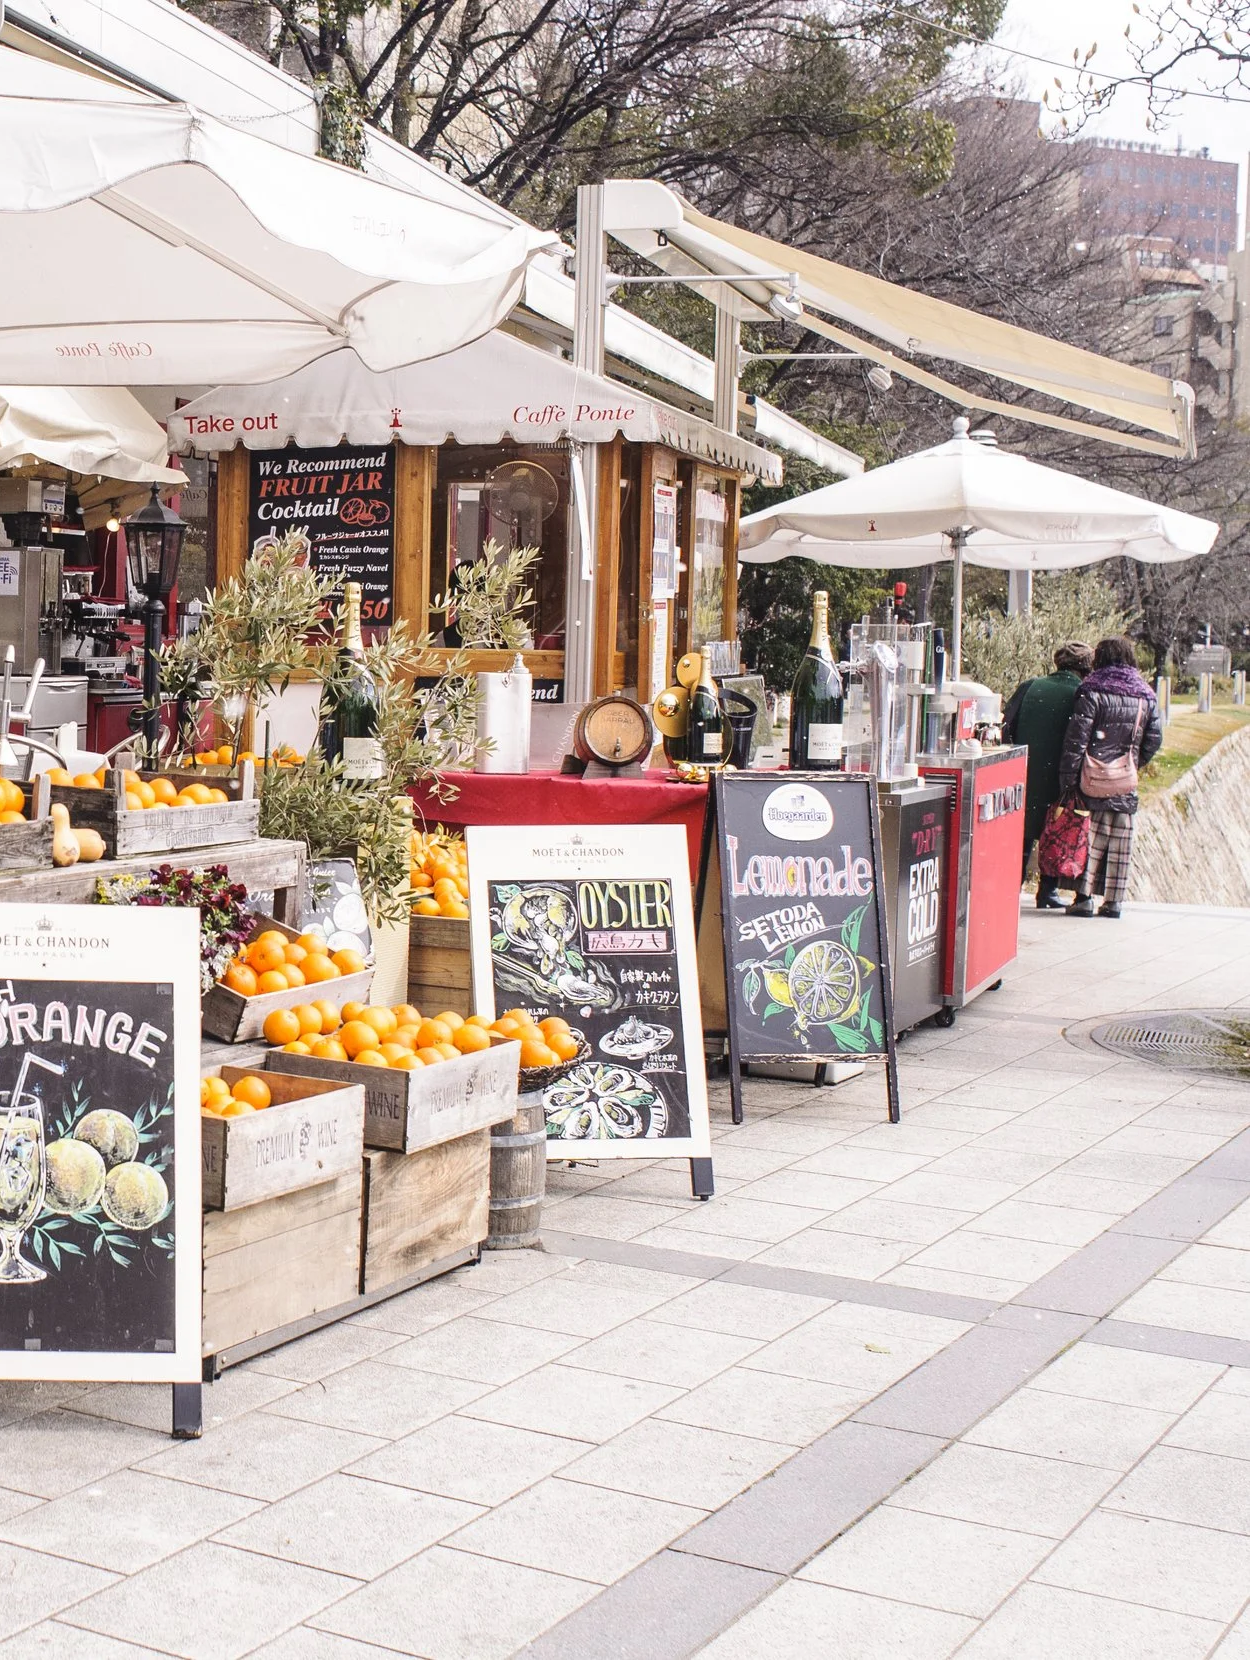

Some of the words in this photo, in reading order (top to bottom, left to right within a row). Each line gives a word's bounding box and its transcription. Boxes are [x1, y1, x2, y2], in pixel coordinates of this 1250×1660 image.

[183, 415, 235, 434] Take
[242, 412, 279, 431] out
[513, 404, 566, 428] Caffè
[575, 404, 635, 422] Ponte
[258, 460, 283, 477] We
[285, 452, 387, 475] Recommend
[258, 475, 333, 498] FRUIT
[336, 471, 383, 495] JAR
[257, 498, 340, 521] Cocktail
[318, 545, 338, 554] Fresh
[339, 545, 362, 554] Cassis
[362, 545, 389, 555] Orange
[318, 564, 340, 572] Fresh
[342, 564, 364, 573] Fuzzy
[366, 563, 389, 572] Navel
[365, 583, 388, 592] Orange
[768, 808, 828, 823] Hoegaarden
[572, 848, 624, 857] CHANDON
[726, 834, 874, 897] Lemonade
[909, 857, 940, 899] EXTRA
[579, 881, 673, 929] OYSTER
[739, 902, 822, 942] SETODA
[907, 892, 939, 945] COLD
[24, 938, 31, 947] &
[36, 936, 110, 949] CHANDON
[591, 933, 664, 950] 広島カキ
[758, 915, 826, 952] LEMON
[3, 951, 85, 959] CHAMPAGNE
[367, 1089, 400, 1119] WINE
[255, 1132, 295, 1167] PREMIUM
[317, 1119, 338, 1149] WINE
